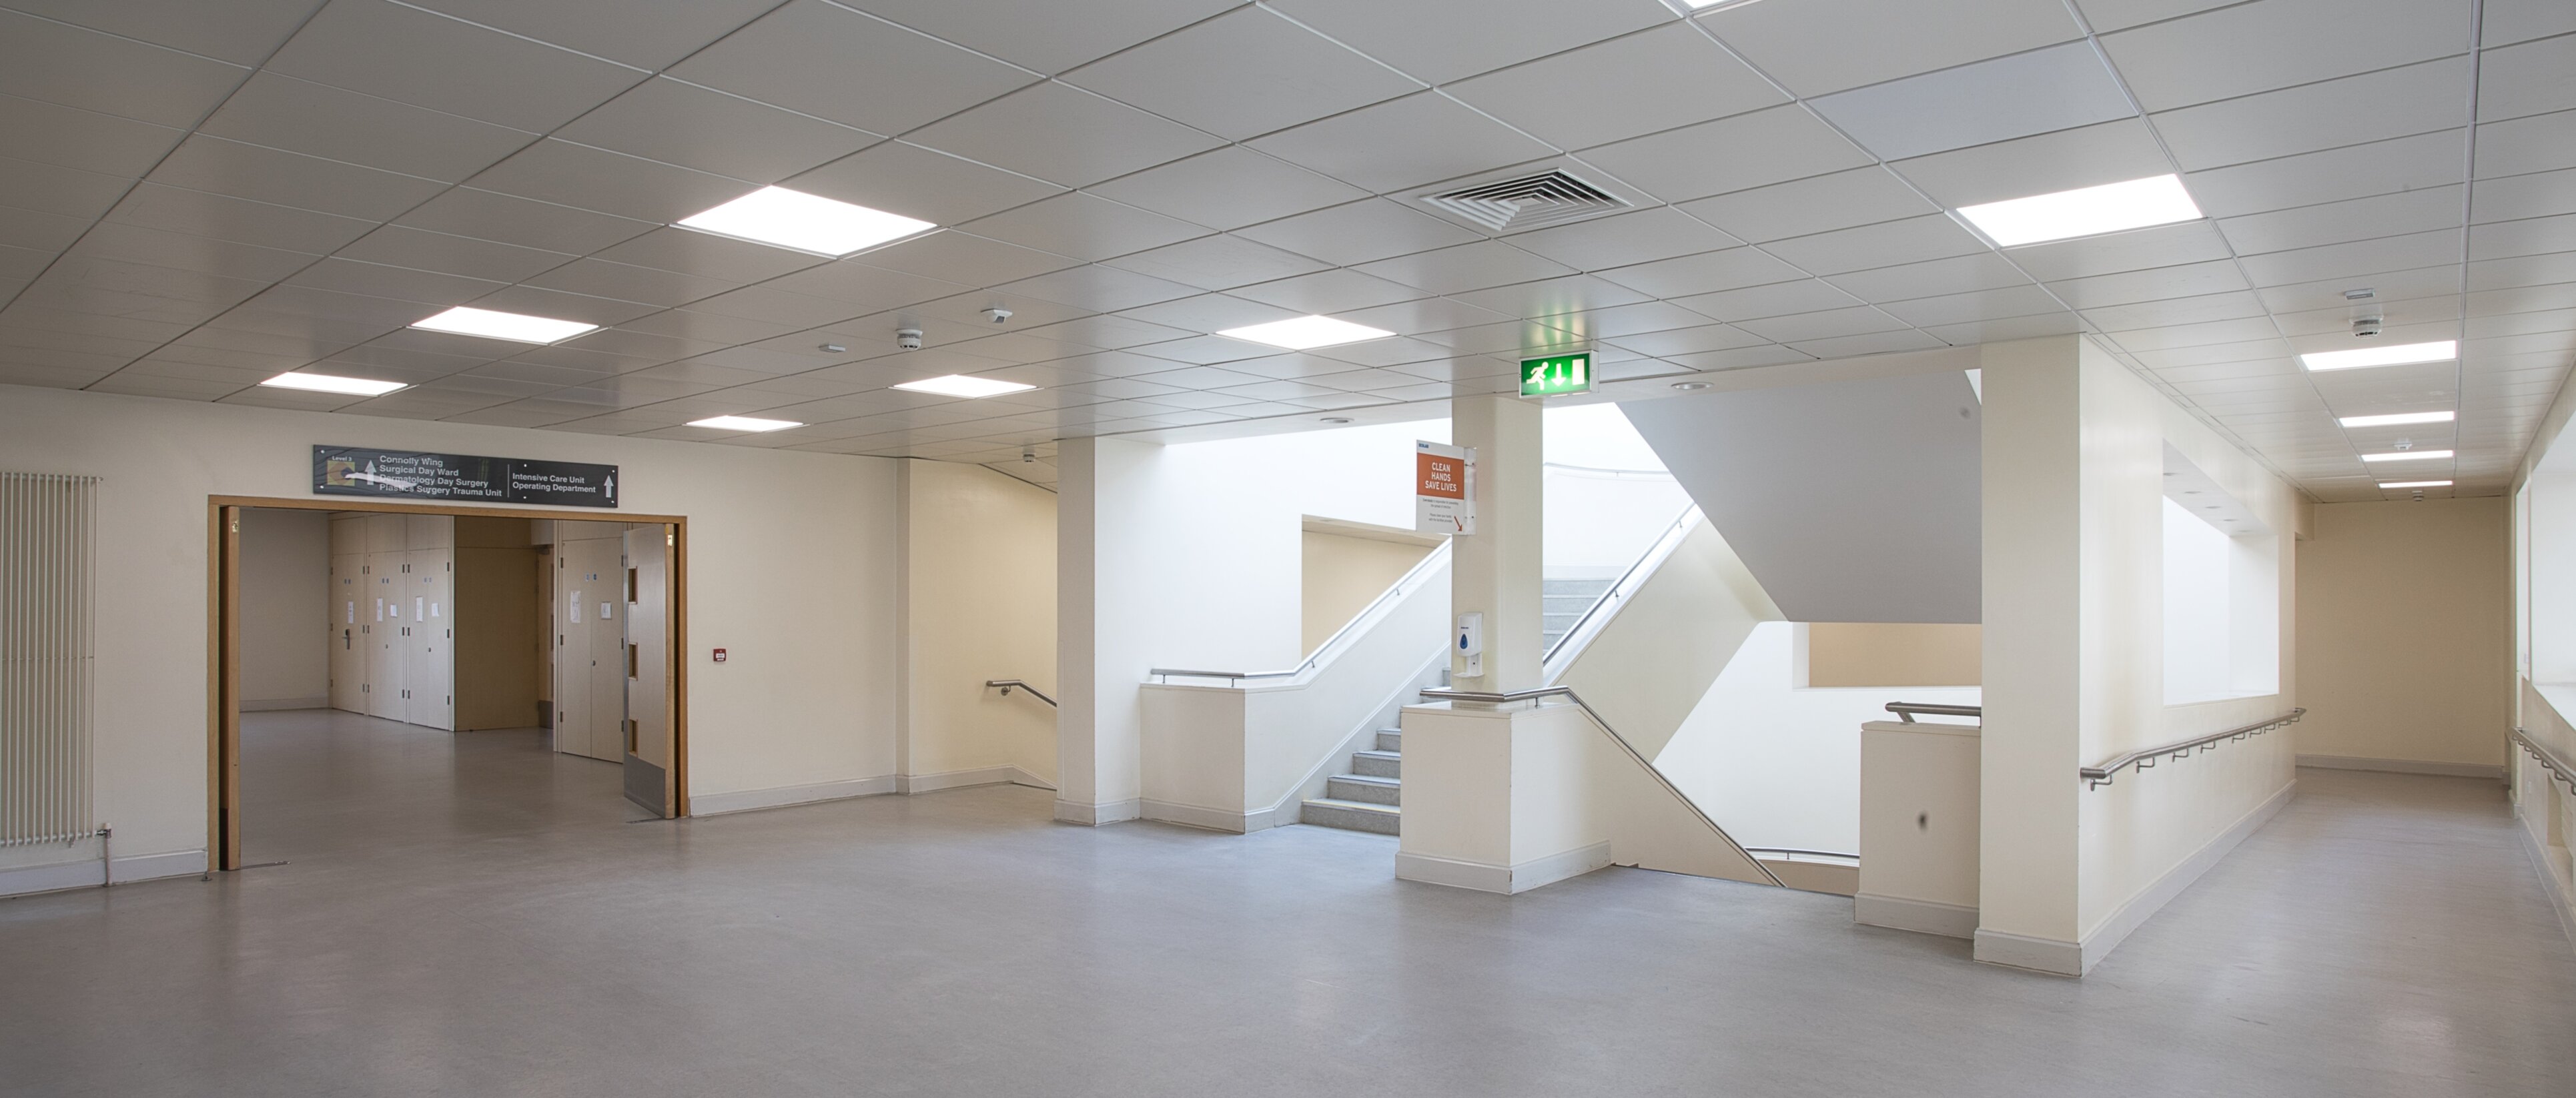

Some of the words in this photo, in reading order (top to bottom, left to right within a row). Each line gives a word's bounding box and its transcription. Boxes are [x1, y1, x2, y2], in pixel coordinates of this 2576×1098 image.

[380, 455, 419, 466] Connolly
[421, 458, 443, 468] Wing
[1432, 462, 1451, 472] CLEAN
[380, 464, 416, 474] Surgical
[418, 467, 435, 476] Day
[437, 468, 458, 476] Ward
[438, 478, 454, 486] Day
[456, 478, 488, 488] Surgery
[512, 472, 548, 481] Intensive
[569, 476, 584, 484] Unit
[1431, 472, 1451, 482] HANDS
[380, 484, 414, 492] Plastics
[416, 486, 450, 496] Surgery
[452, 487, 483, 496] Trauma
[485, 489, 502, 497] Unit
[512, 482, 551, 492] Operating
[552, 484, 596, 493] Department
[1425, 480, 1440, 490] SAVE
[1441, 482, 1456, 492] LIVES
